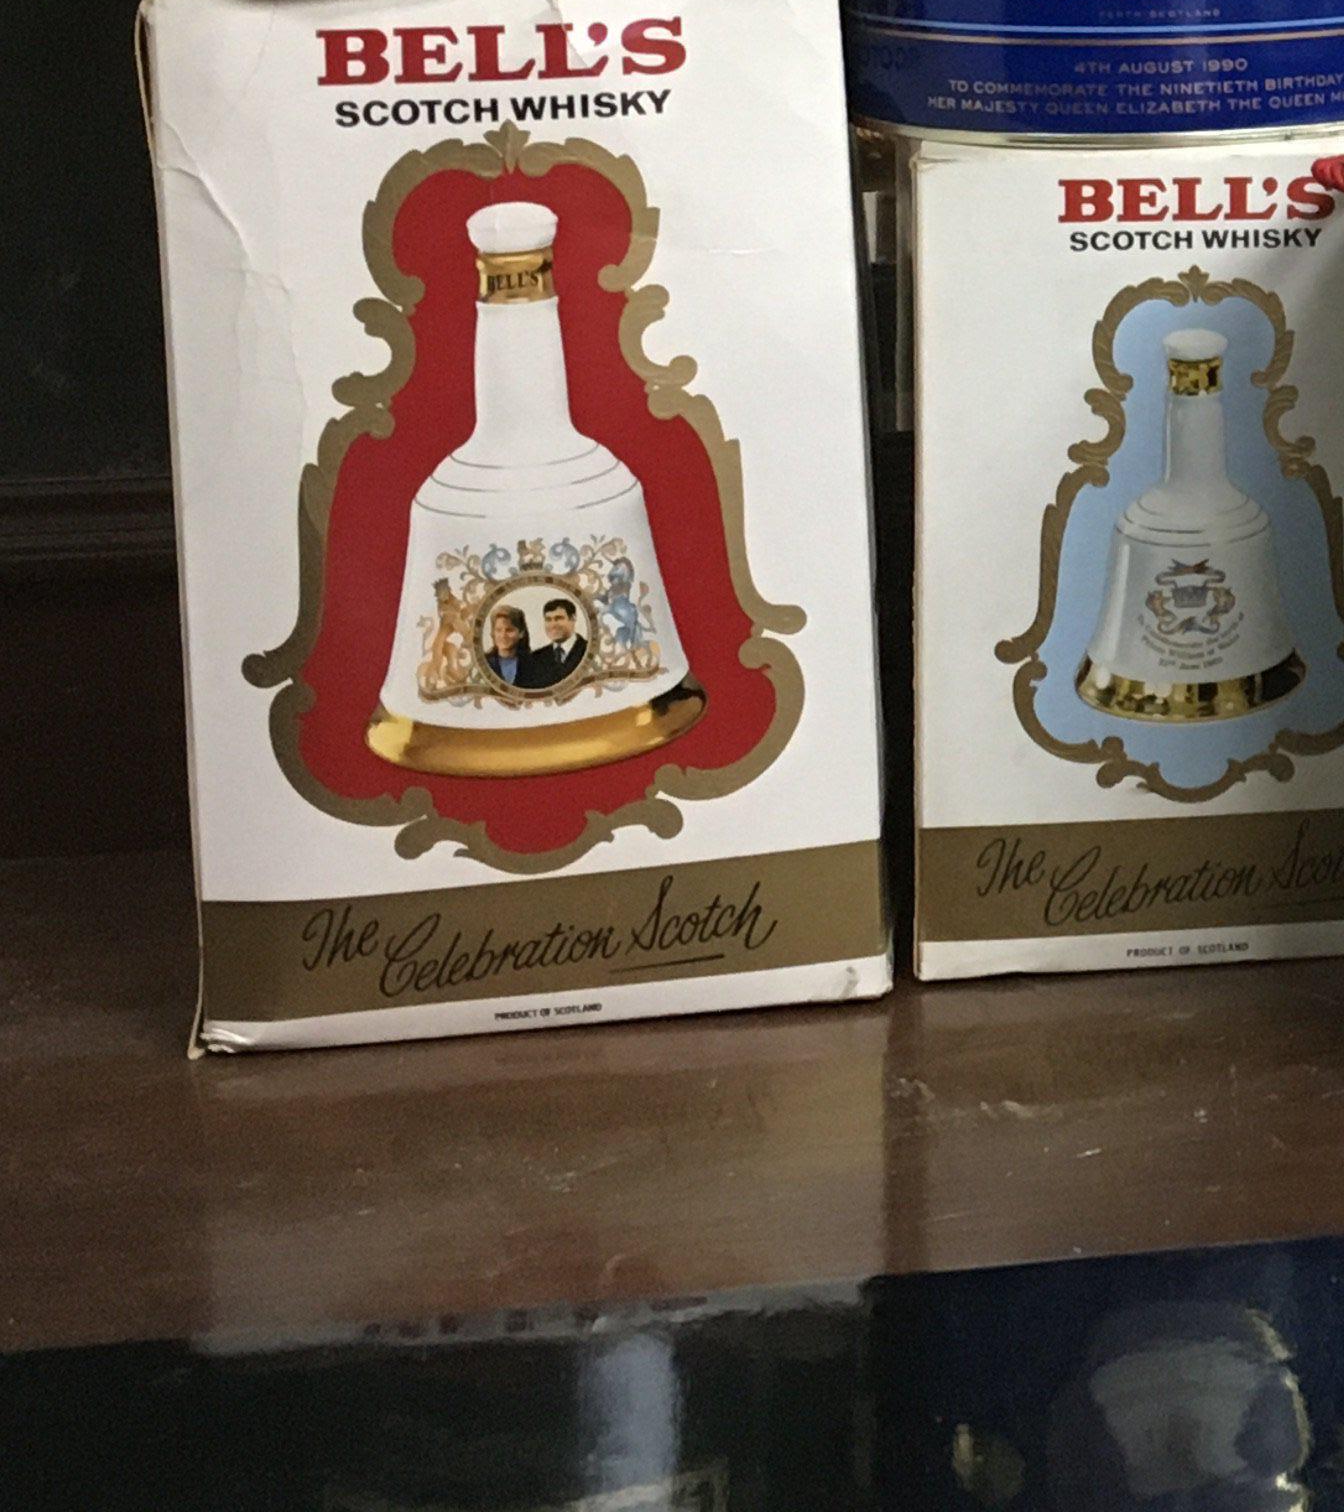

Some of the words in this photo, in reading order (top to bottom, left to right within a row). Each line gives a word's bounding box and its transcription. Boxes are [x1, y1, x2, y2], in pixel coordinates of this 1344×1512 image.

[316, 16, 686, 86] BELL'S
[1118, 59, 1193, 73] AUGUST
[1202, 58, 1249, 72] 1990
[336, 98, 500, 127] SCOTCH
[511, 90, 671, 121] WHISKY
[1058, 176, 1336, 224] BELL'S
[1070, 230, 1193, 251] SCOTCH
[1202, 228, 1323, 250] WHISKY
[976, 837, 1046, 896] The
[1044, 845, 1257, 927] Celebration
[302, 907, 377, 969] The
[380, 914, 618, 997] Celebration
[627, 875, 776, 955] Scotch
[1126, 946, 1173, 959] PRODUCT
[1197, 942, 1250, 955] SCOTLAND
